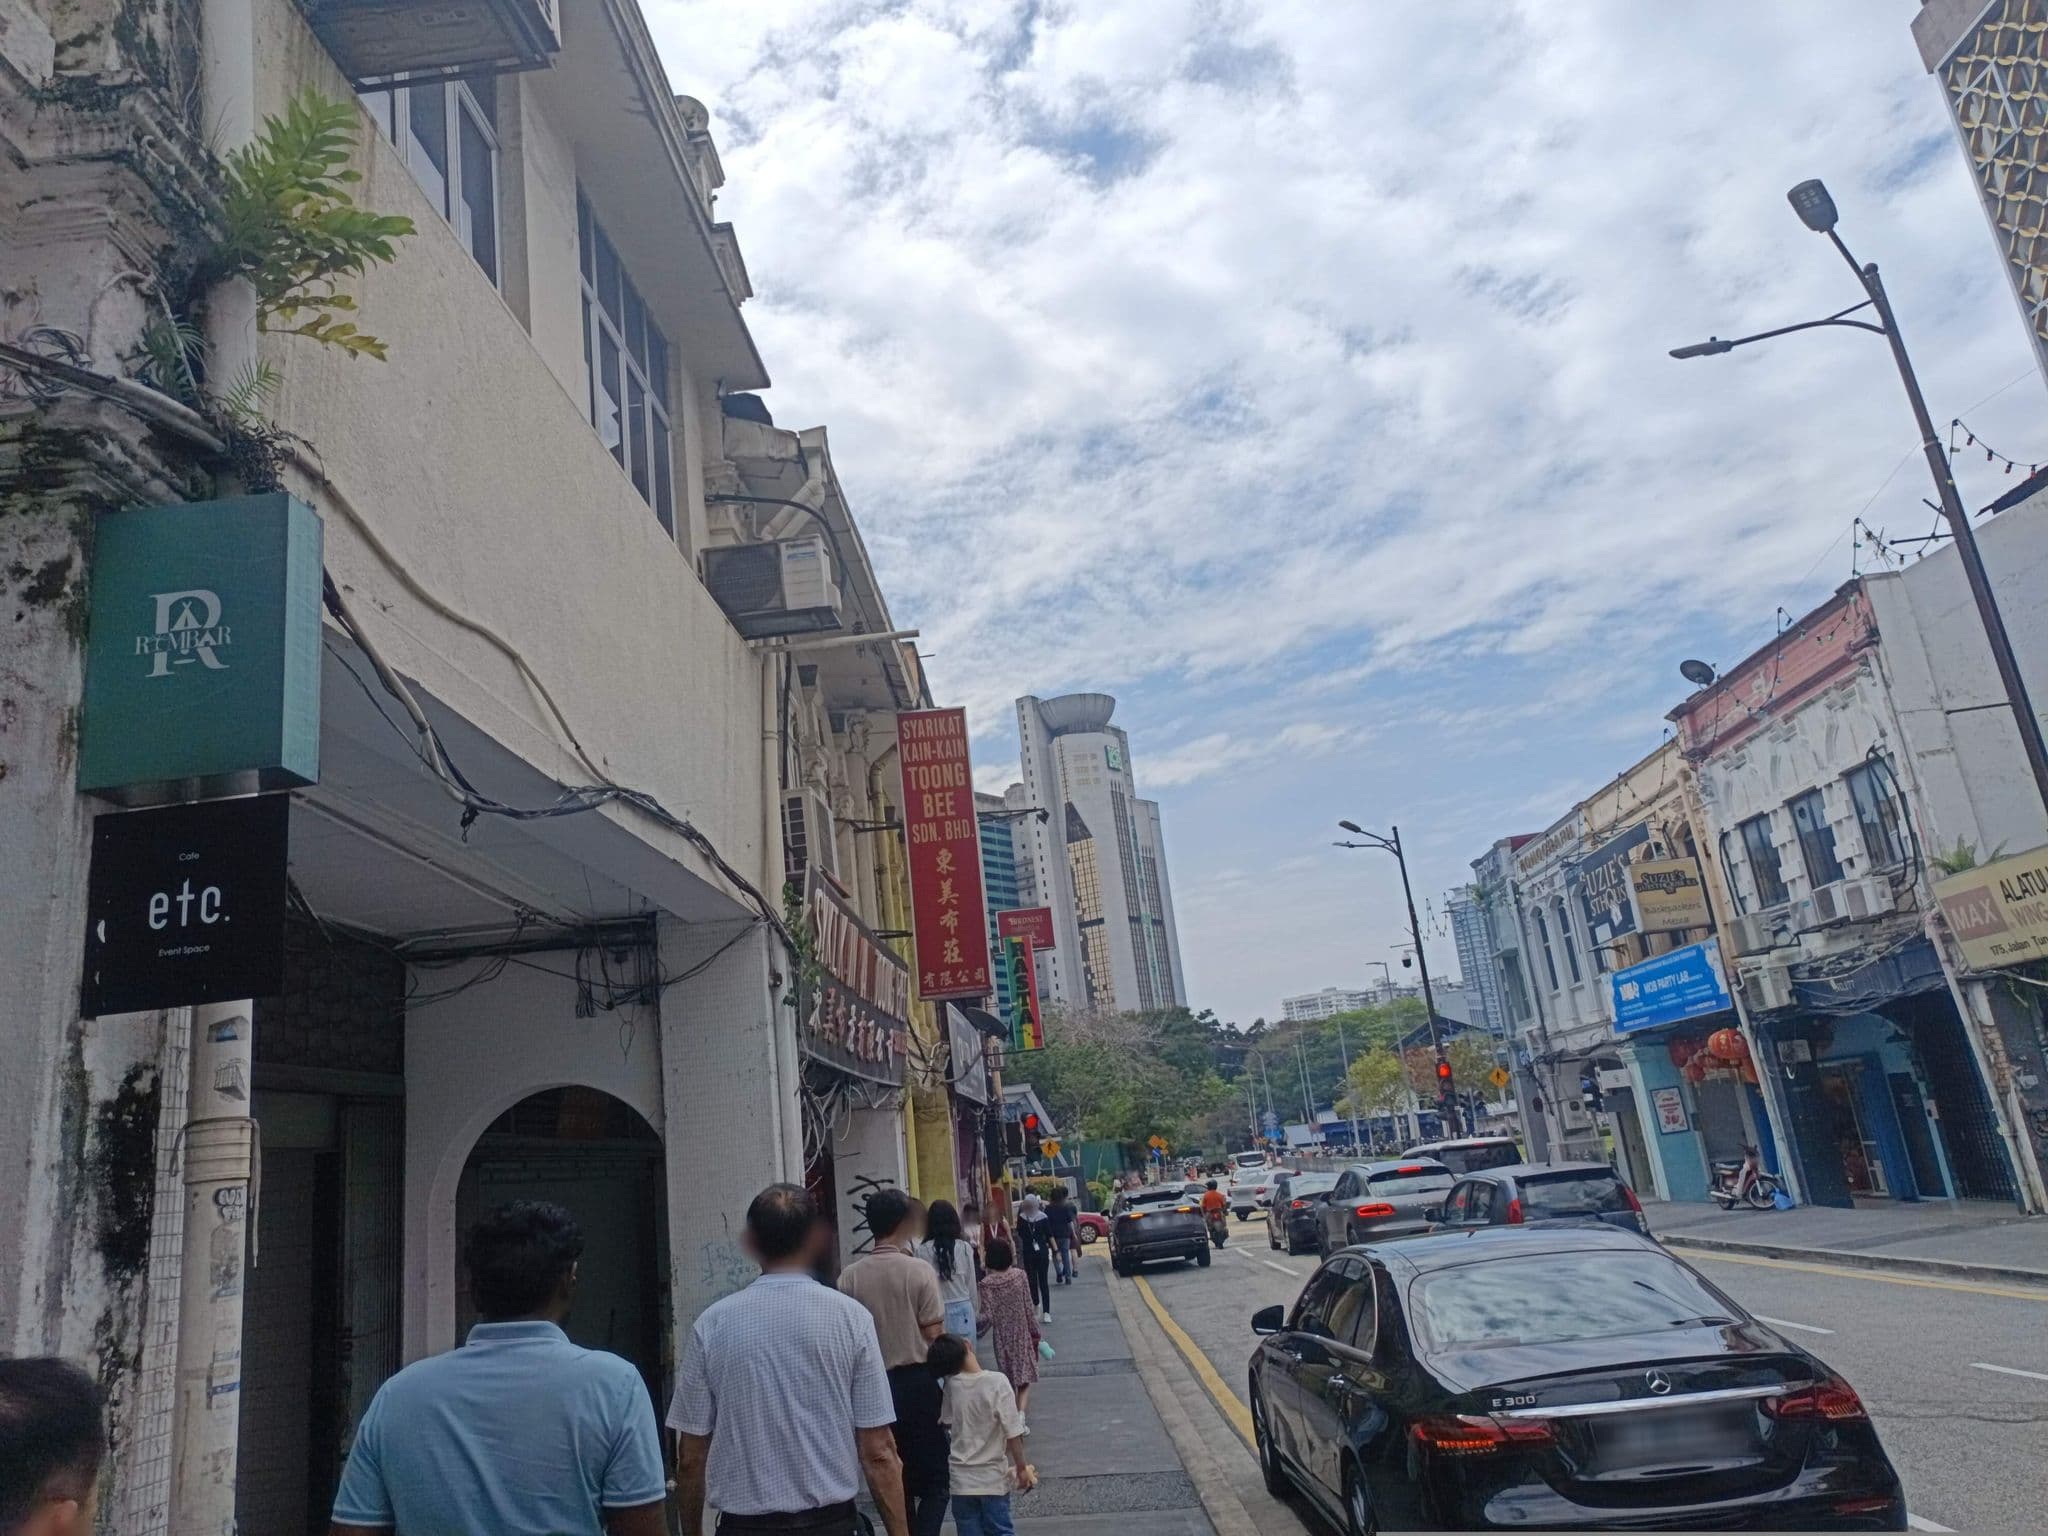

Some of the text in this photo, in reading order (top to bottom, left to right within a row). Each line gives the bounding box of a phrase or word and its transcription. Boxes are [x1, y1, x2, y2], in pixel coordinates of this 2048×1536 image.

[902, 715, 961, 740] SYARIKAT
[902, 739, 967, 763] KAIN-KAIN
[907, 762, 966, 791] TOONG
[922, 791, 957, 818] BEE
[912, 819, 975, 844] SDN. BHD.
[179, 851, 200, 861] Cafe
[1999, 865, 2048, 904] ALATU
[148, 878, 230, 930] etc.
[1951, 899, 1997, 931] MAX
[158, 944, 210, 957] Event Space
[1492, 1395, 1536, 1407] E 300
